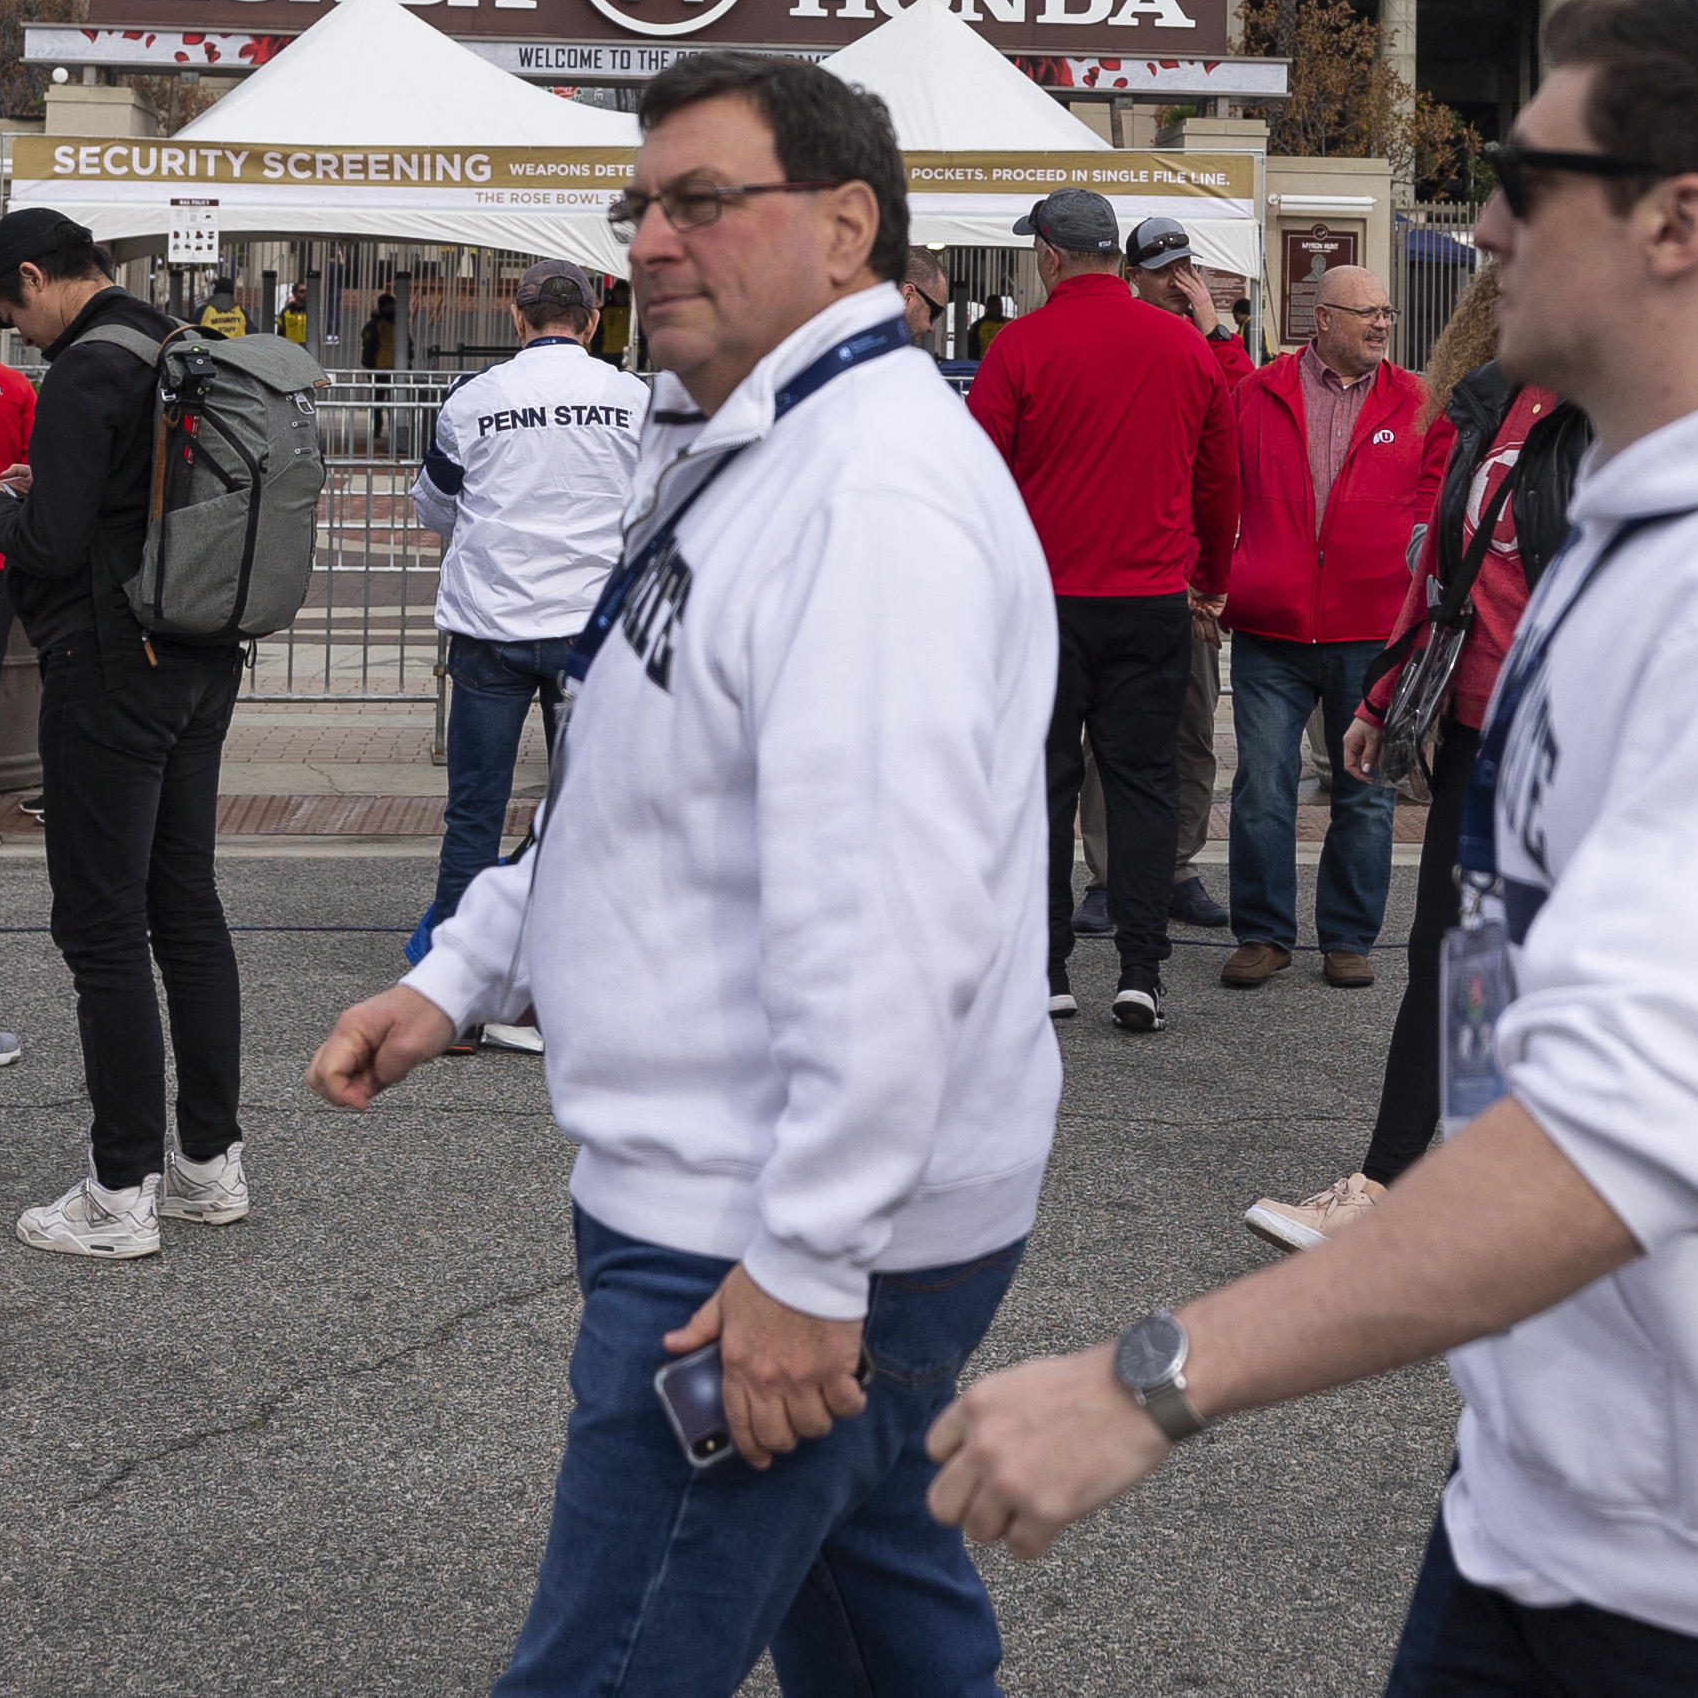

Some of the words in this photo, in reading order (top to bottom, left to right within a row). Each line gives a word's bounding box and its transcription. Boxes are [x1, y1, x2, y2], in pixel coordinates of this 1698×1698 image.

[519, 47, 603, 70] WELCOME
[609, 49, 631, 70] TO
[638, 50, 670, 71] THE
[53, 145, 250, 176] SECURITY
[262, 151, 493, 182] SCREENING
[508, 163, 591, 176] WEAPONS
[594, 164, 635, 177] DETE
[911, 167, 988, 181] POCKETS.
[992, 168, 1067, 182] PROCEED
[1072, 169, 1088, 182] IN
[1092, 169, 1149, 183] SINGLE
[1153, 170, 1186, 184] FILE
[1191, 172, 1231, 186] LINE.
[475, 192, 505, 203] THE
[510, 193, 549, 204] ROSE
[556, 193, 604, 204] BOWL
[477, 407, 547, 437] PENN
[554, 405, 631, 429] STATE
